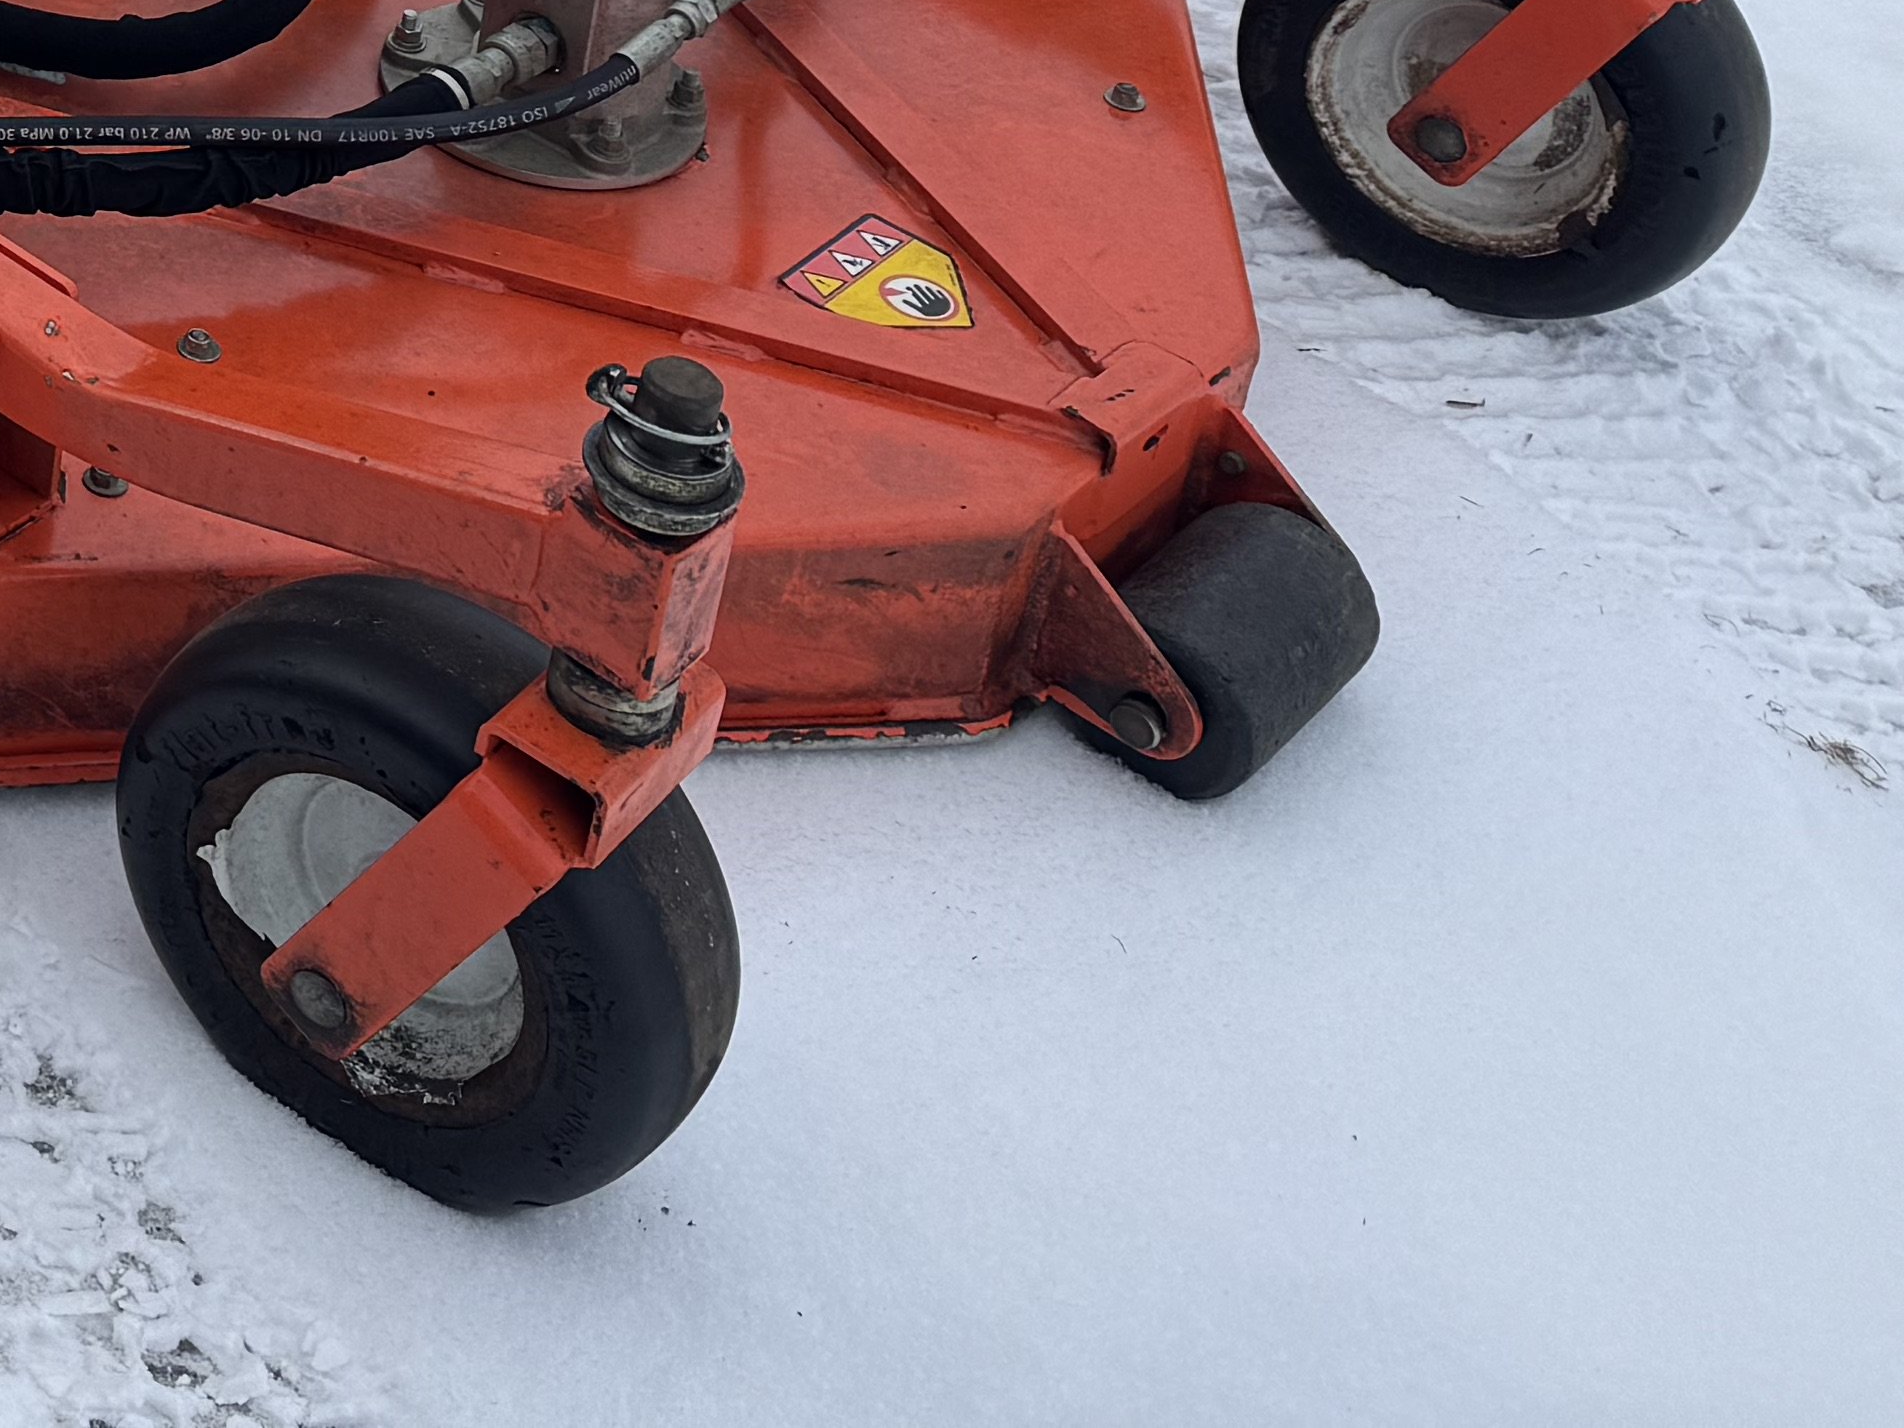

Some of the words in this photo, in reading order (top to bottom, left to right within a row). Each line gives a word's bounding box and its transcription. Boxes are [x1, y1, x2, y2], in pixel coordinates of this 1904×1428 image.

[521, 106, 549, 125] ISO
[449, 112, 517, 137] 18752-A
[20, 126, 54, 141] MPa
[59, 126, 93, 140] 21.0
[98, 126, 125, 139] bar
[129, 126, 159, 140] 210
[164, 126, 192, 140] WP
[271, 127, 291, 141] 10
[297, 128, 323, 142] DN
[338, 127, 399, 143] 100R17
[403, 126, 435, 141] SAE
